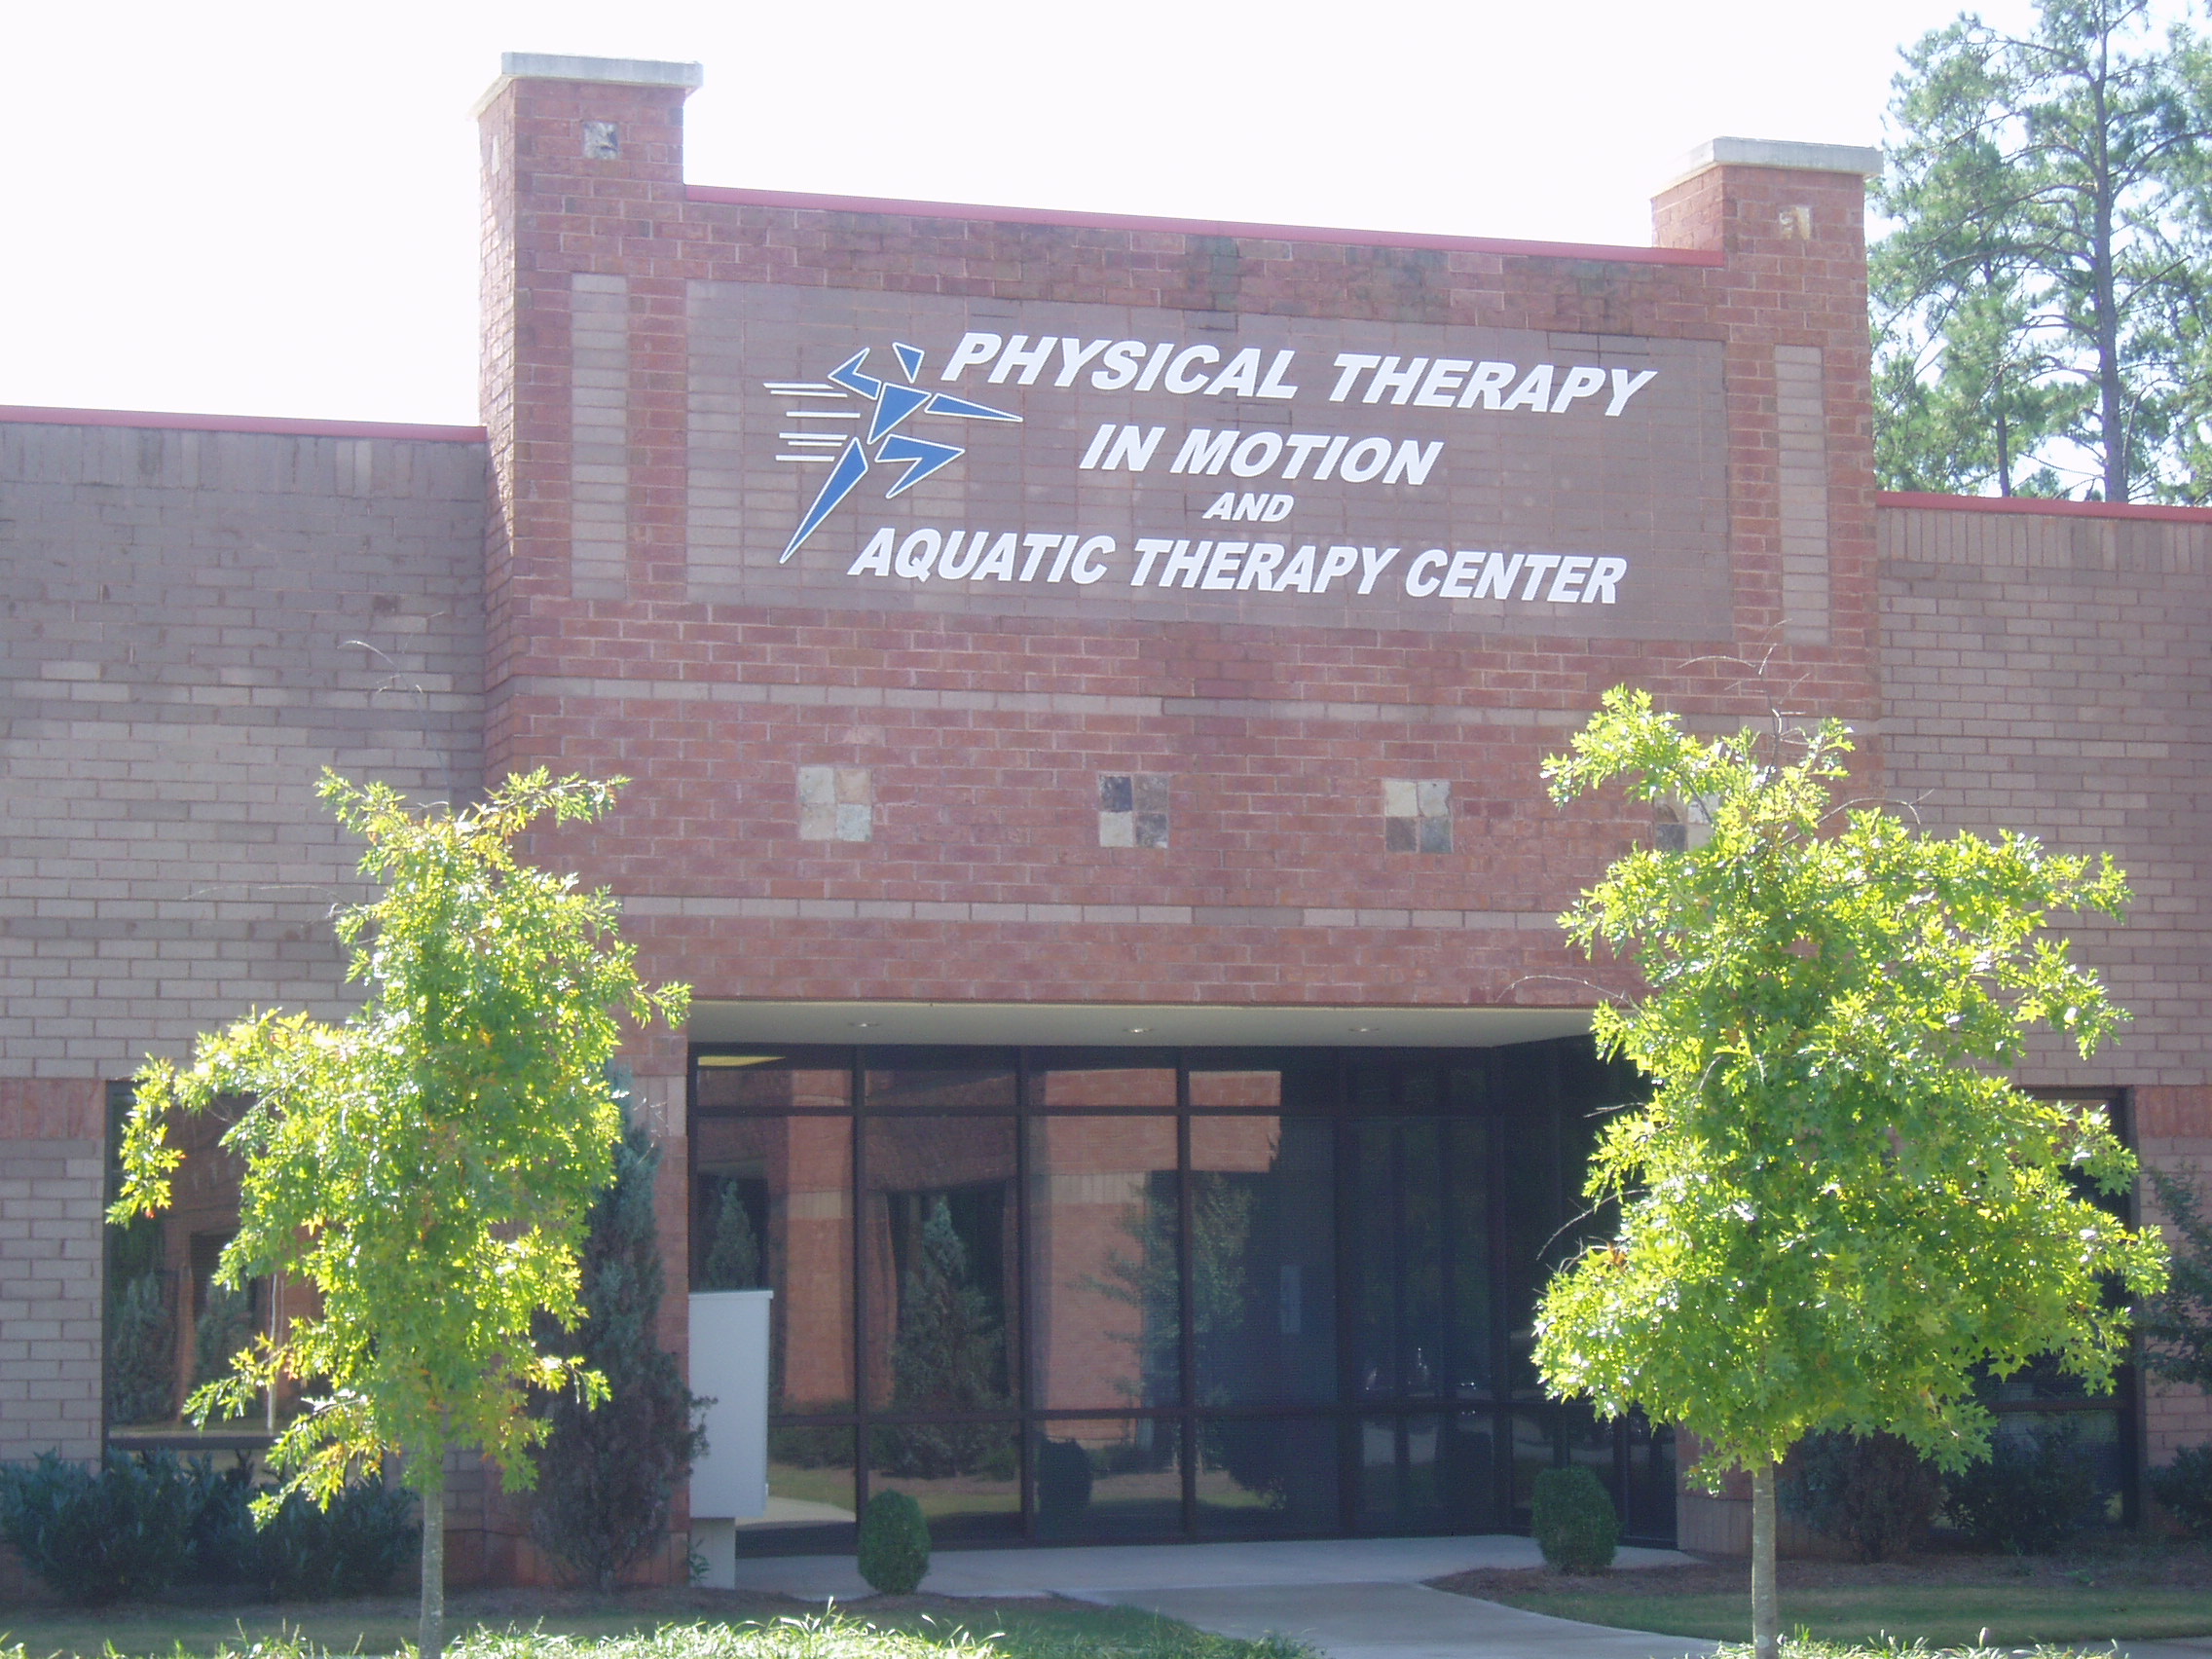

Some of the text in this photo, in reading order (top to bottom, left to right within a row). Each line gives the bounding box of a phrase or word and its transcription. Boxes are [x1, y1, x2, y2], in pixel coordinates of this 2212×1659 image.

[940, 332, 1658, 417] PHYSICAL THERAPY
[1079, 424, 1445, 486] IN MOTION
[1201, 492, 1295, 523] AND
[846, 527, 1628, 605] AQUATIC THERAPY CENTER
